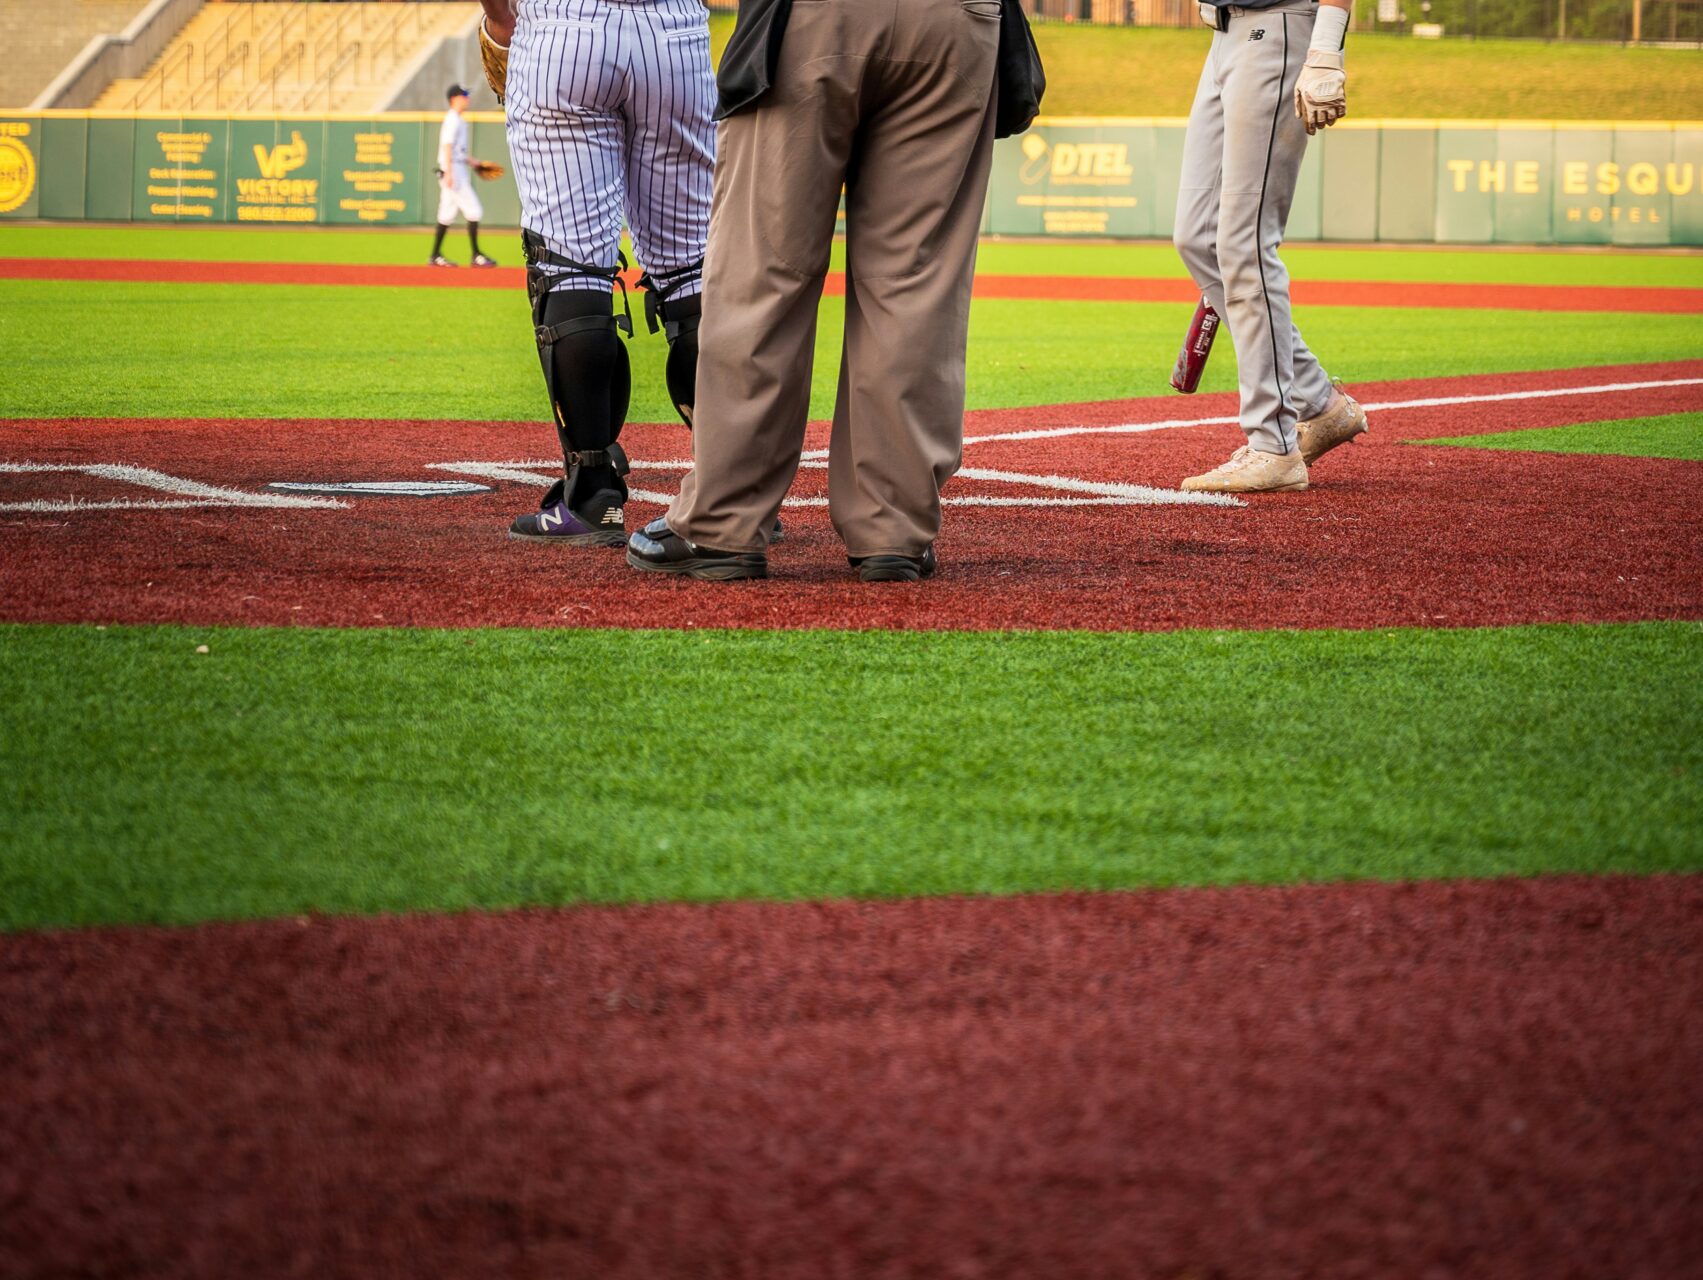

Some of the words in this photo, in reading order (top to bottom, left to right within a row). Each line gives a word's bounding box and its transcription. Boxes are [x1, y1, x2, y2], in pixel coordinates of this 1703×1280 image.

[1051, 143, 1134, 177] DTEL
[236, 178, 318, 196] VICTORY
[1447, 160, 1539, 194] THE
[1563, 161, 1703, 195] ESQU
[1567, 207, 1661, 223] HOTEL
